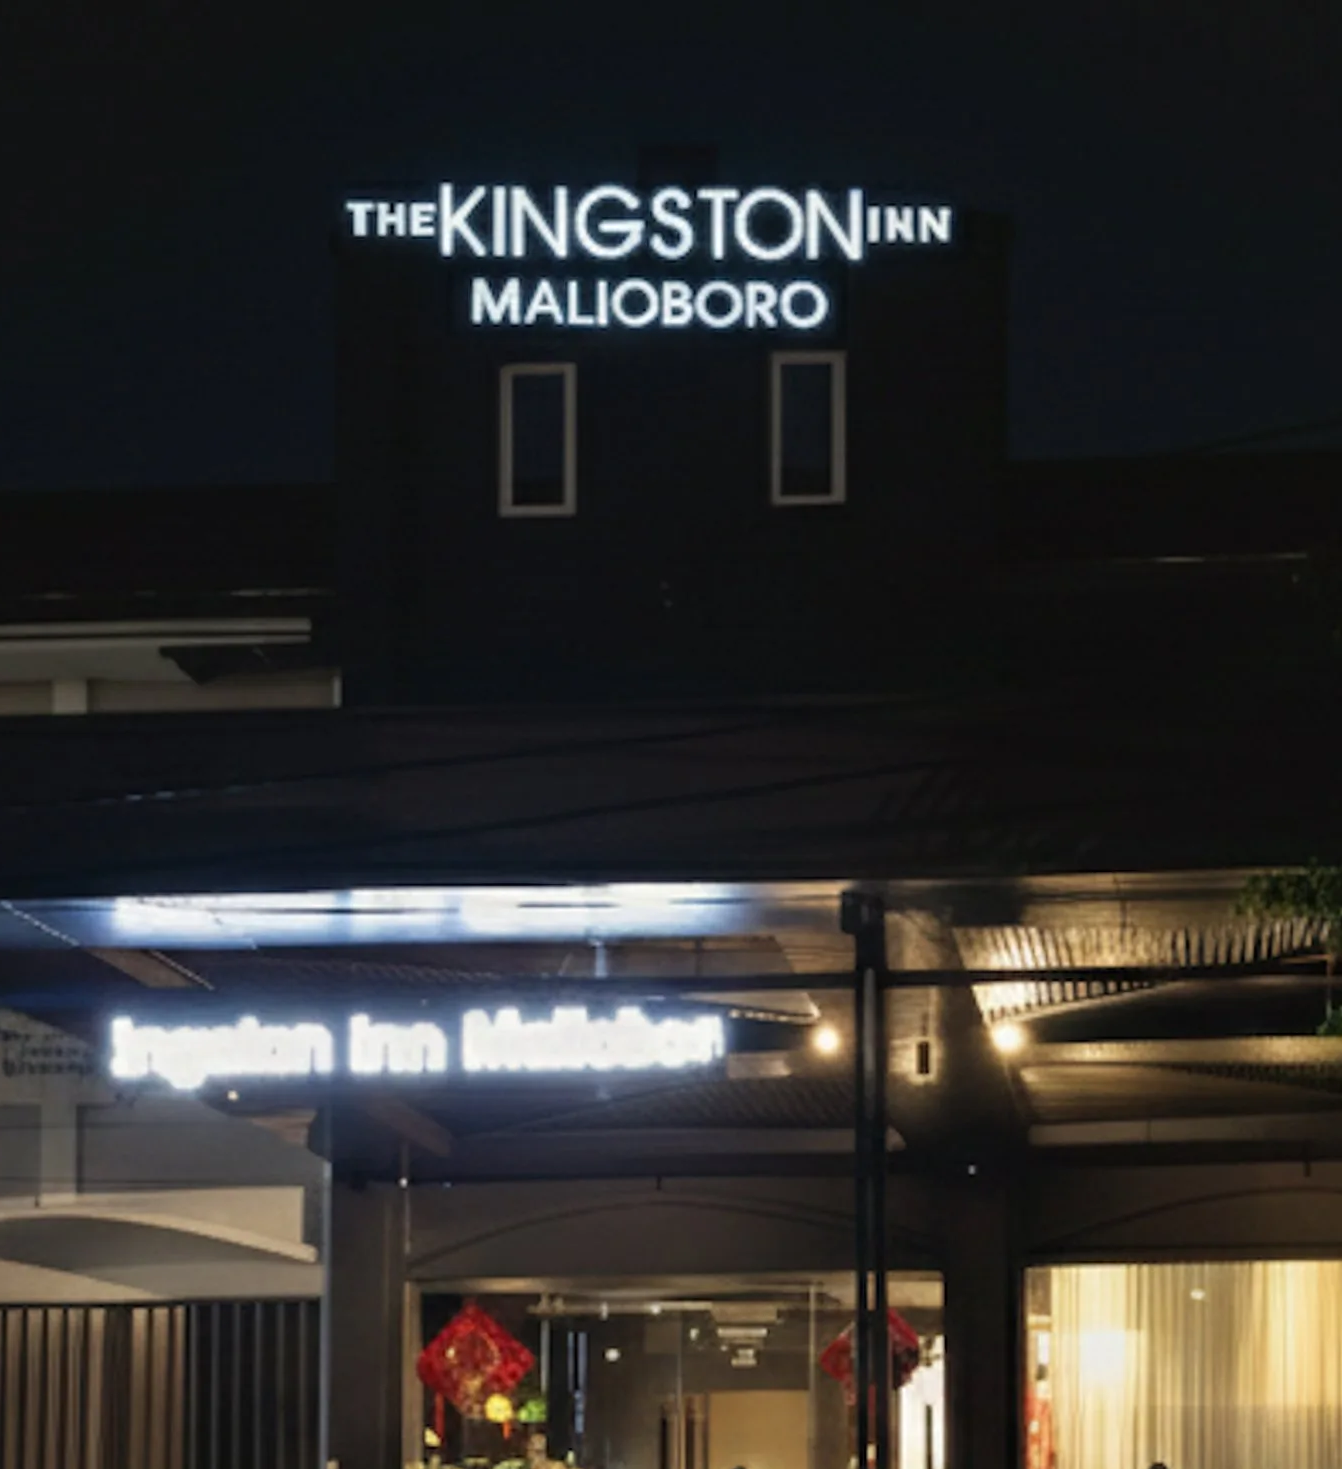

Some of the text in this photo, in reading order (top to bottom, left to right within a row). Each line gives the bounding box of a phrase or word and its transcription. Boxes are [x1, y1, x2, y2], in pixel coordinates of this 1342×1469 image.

[345, 182, 952, 262] THE KINGSTON INN
[470, 277, 830, 330] MALIOBORO
